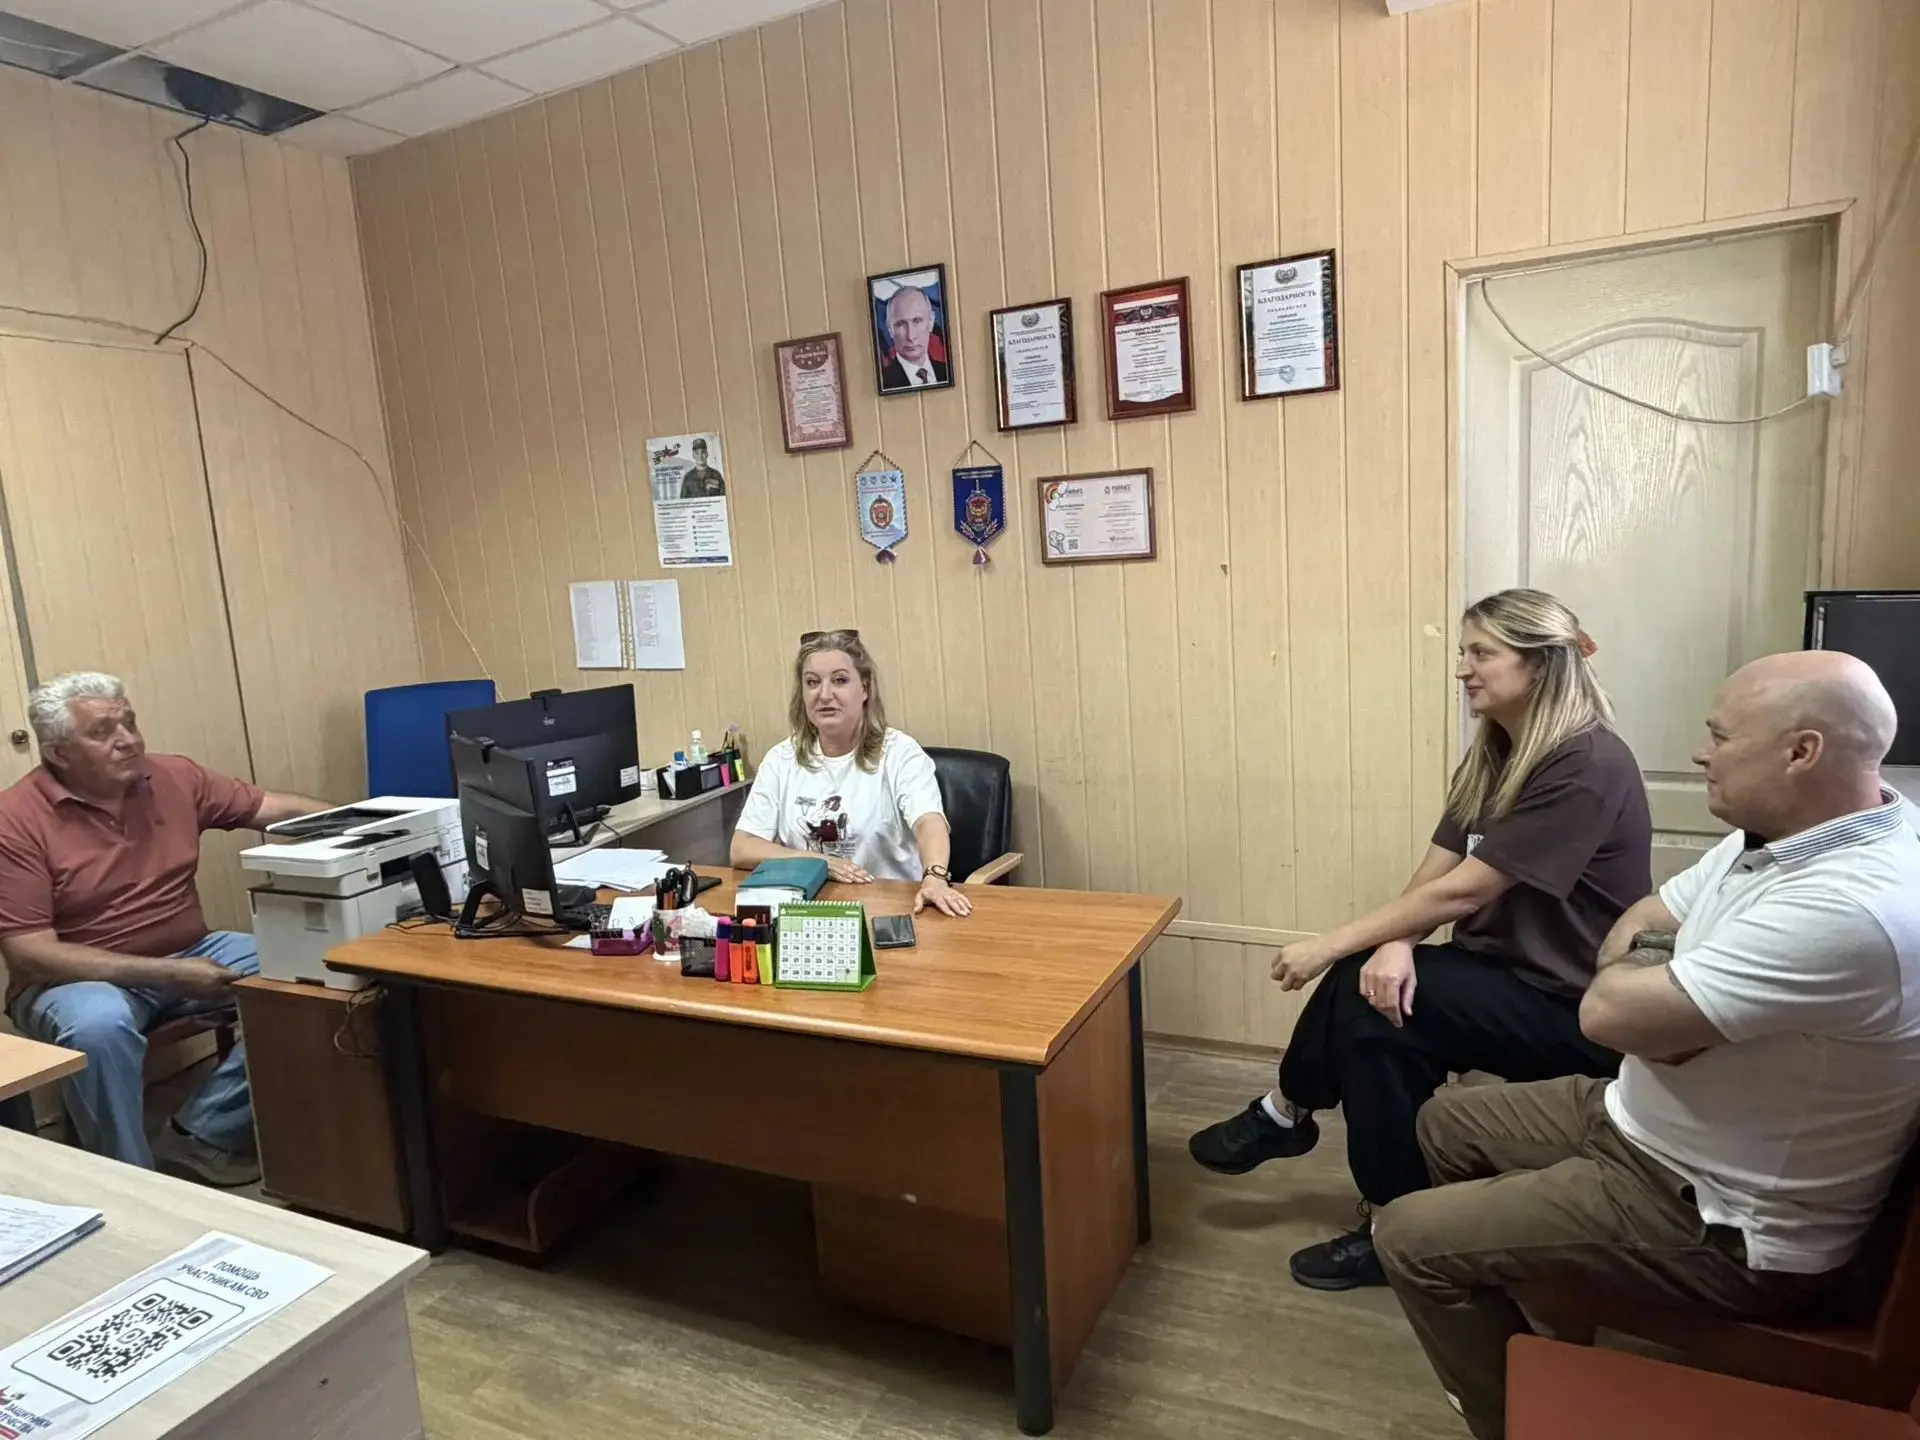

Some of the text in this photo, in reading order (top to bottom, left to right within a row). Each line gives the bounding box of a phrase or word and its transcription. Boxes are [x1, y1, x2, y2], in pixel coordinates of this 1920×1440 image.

[176, 1264, 269, 1300] УЧАСТНИКАМ СВО
[212, 1261, 261, 1280] ПОМОЩЬ
